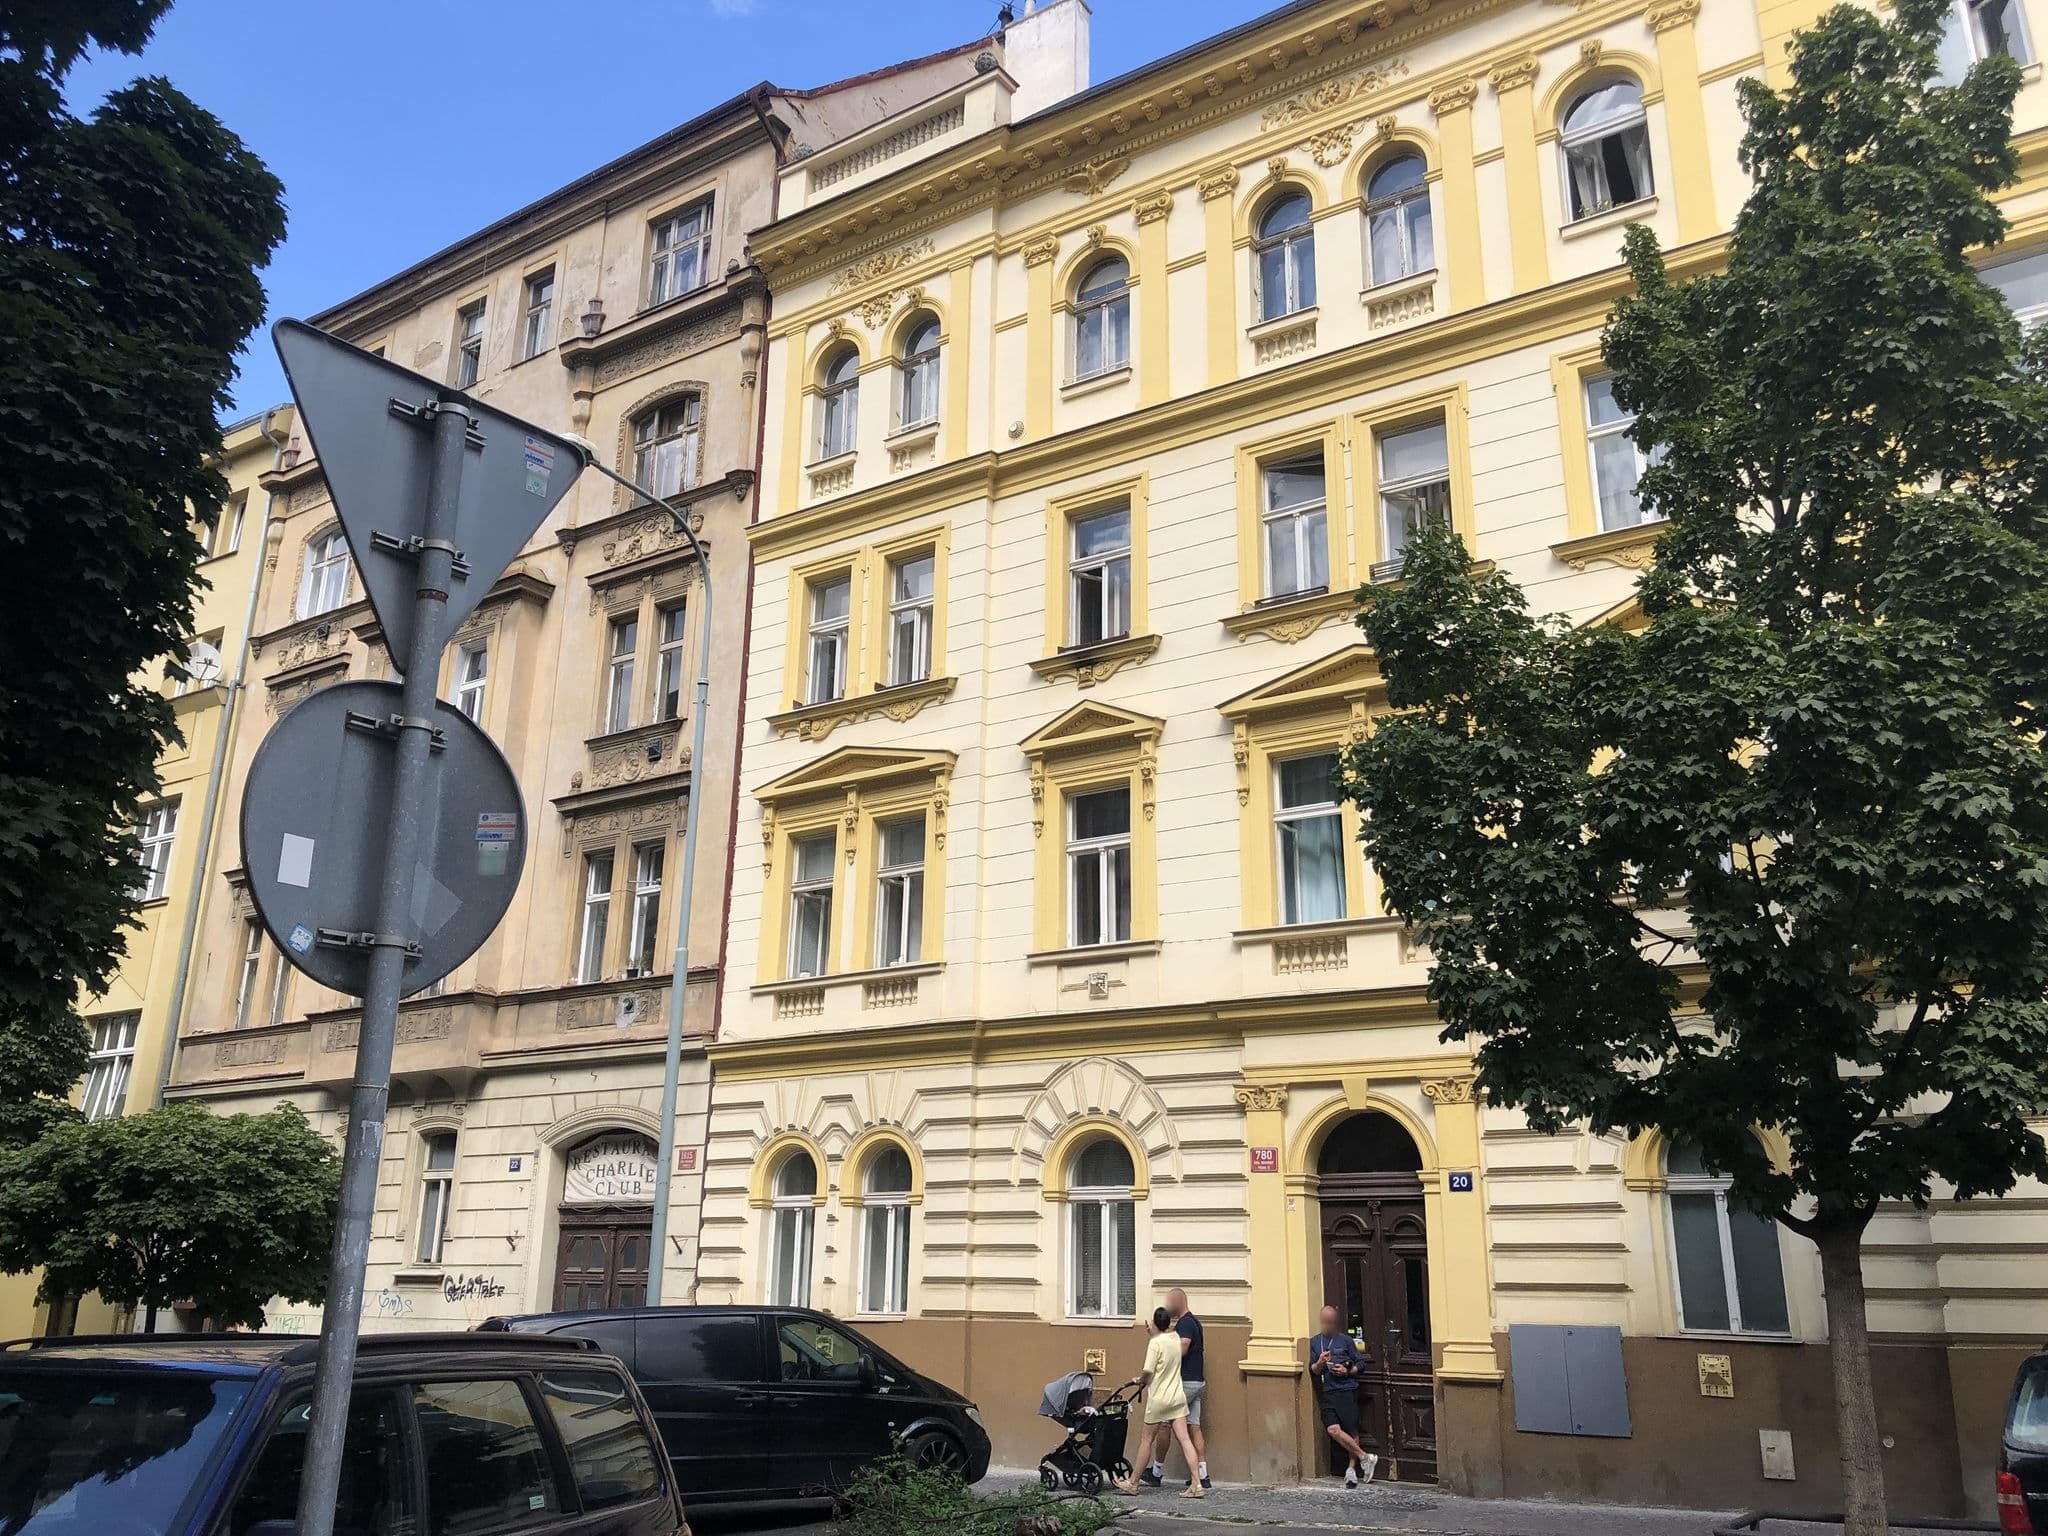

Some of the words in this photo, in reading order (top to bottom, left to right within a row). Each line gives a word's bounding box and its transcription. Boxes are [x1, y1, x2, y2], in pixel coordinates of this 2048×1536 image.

[571, 1140, 658, 1171] RESTAURA
[1255, 1150, 1273, 1161] 780
[511, 1160, 519, 1169] 22
[586, 1160, 655, 1184] CHARLIE
[595, 1181, 642, 1196] CLUB
[1452, 1176, 1468, 1188] 20
